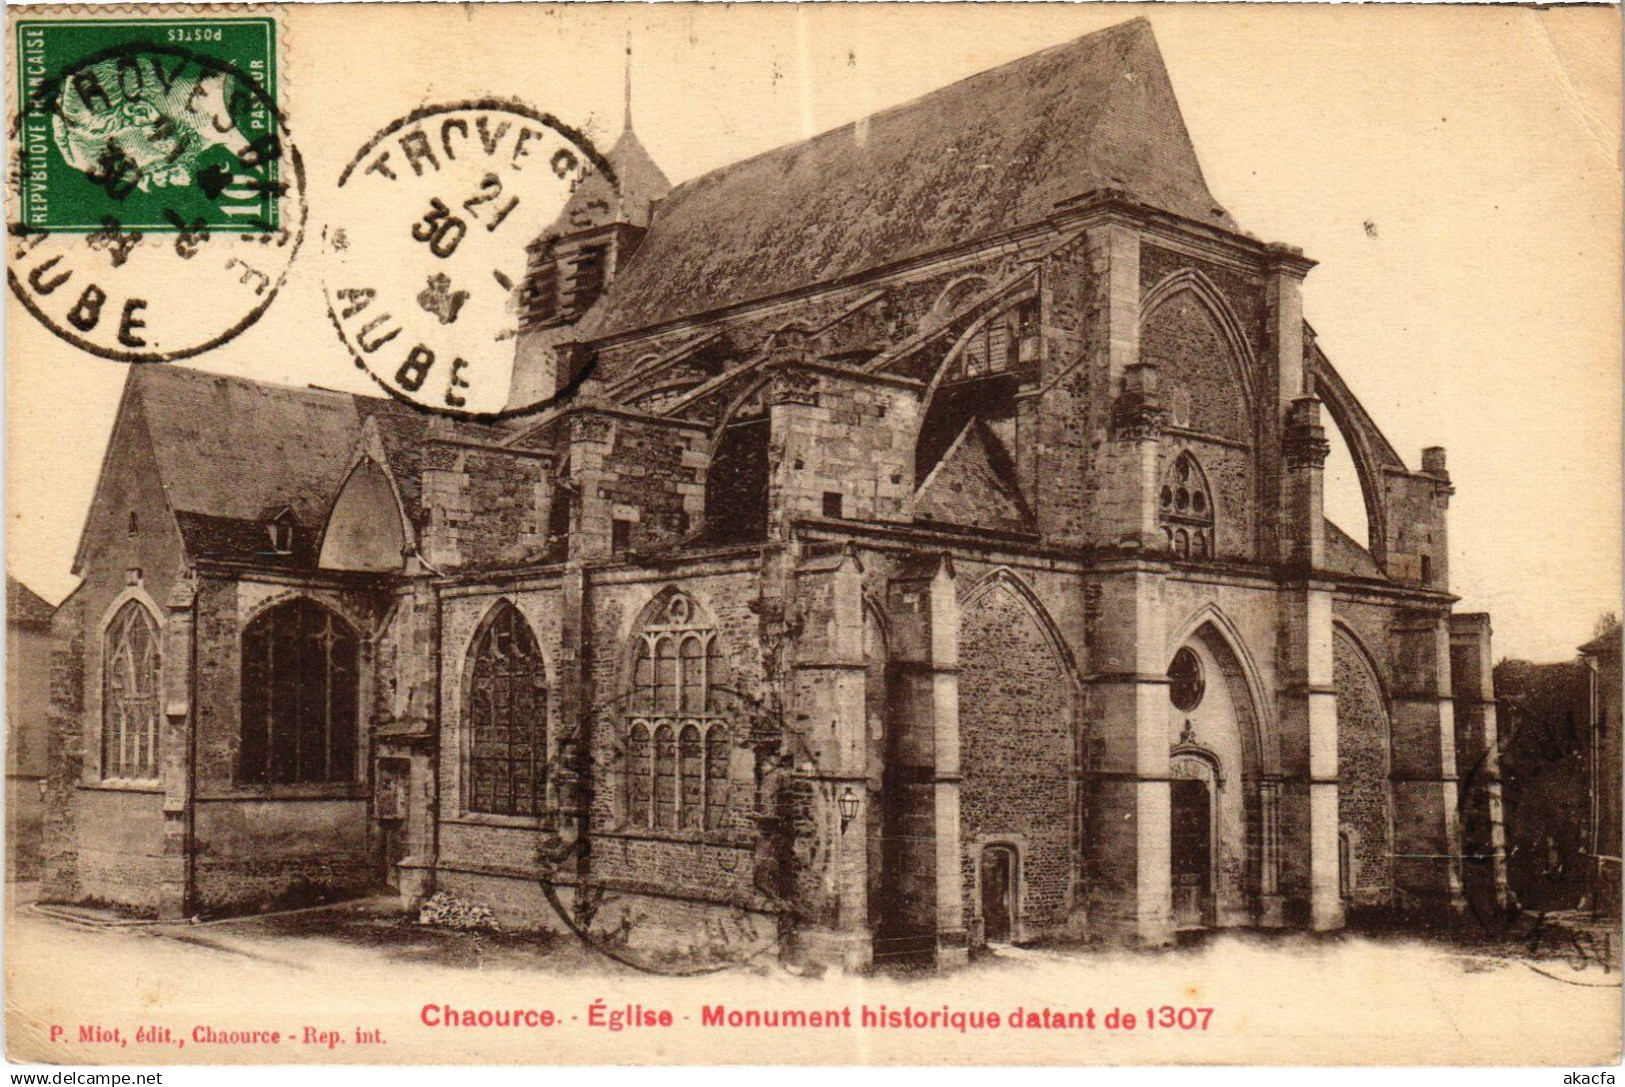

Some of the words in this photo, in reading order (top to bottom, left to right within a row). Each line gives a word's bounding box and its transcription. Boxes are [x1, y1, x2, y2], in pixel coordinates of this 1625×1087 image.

[168, 29, 222, 41] POSTES
[411, 197, 467, 259] 30
[337, 287, 471, 407] AUBE
